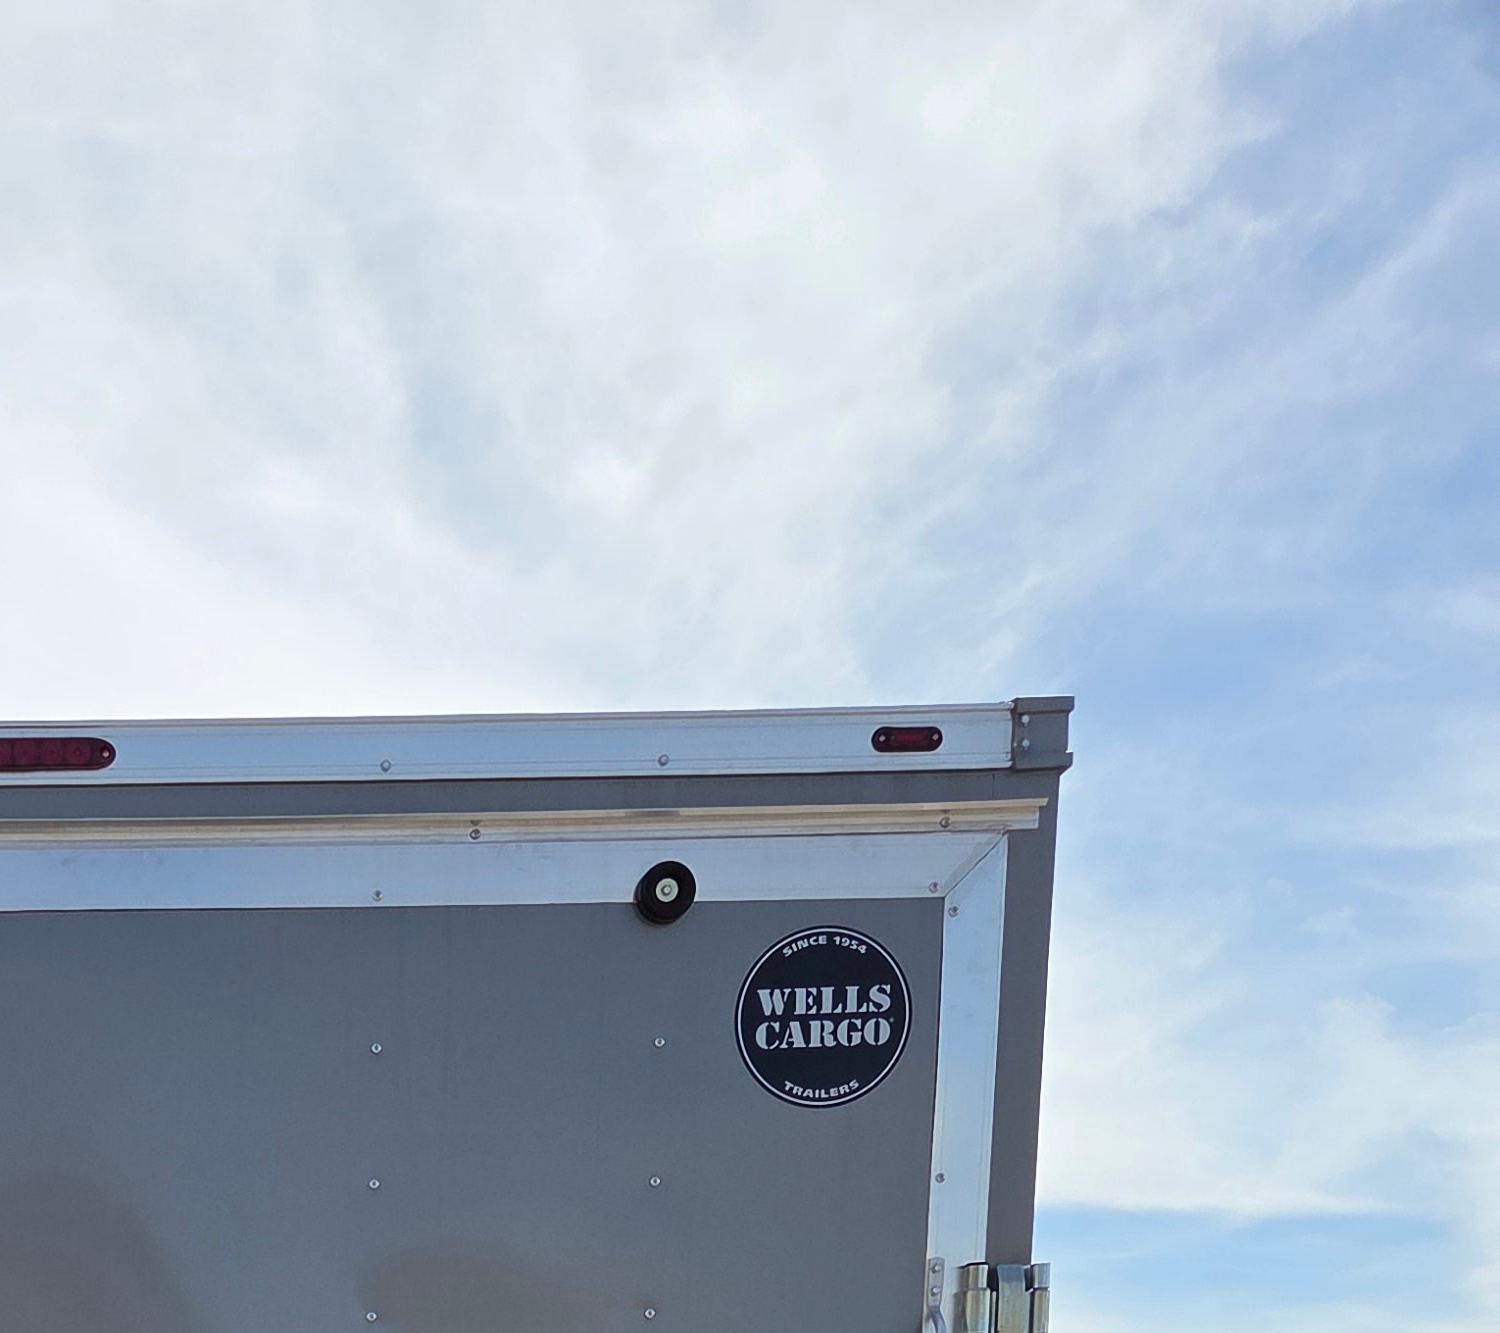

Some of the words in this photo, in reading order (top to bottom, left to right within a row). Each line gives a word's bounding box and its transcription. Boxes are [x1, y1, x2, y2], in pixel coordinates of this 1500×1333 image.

[782, 935, 827, 958] SINCE
[833, 936, 867, 955] 1954
[756, 984, 891, 1016] WELLS
[755, 1017, 891, 1050] CARGO
[783, 1079, 860, 1099] TRAILERS
